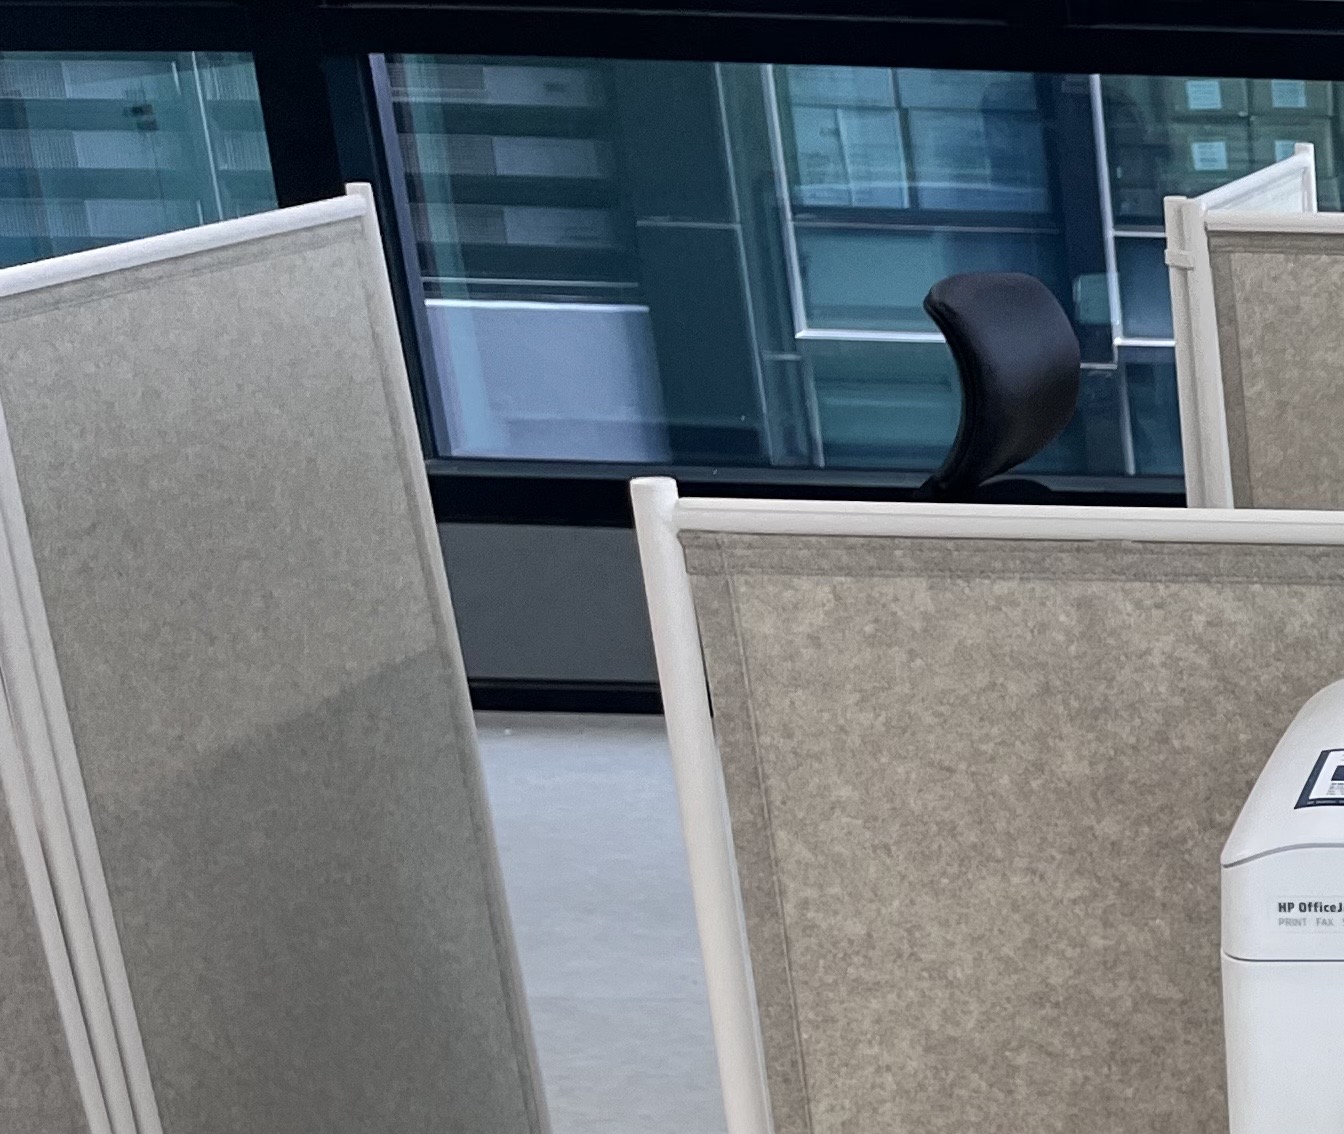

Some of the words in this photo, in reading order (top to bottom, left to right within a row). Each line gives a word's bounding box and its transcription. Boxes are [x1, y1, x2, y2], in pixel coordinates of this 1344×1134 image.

[1278, 902, 1294, 913] HP
[1278, 918, 1307, 927] PRINT
[1316, 918, 1334, 927] FAX
